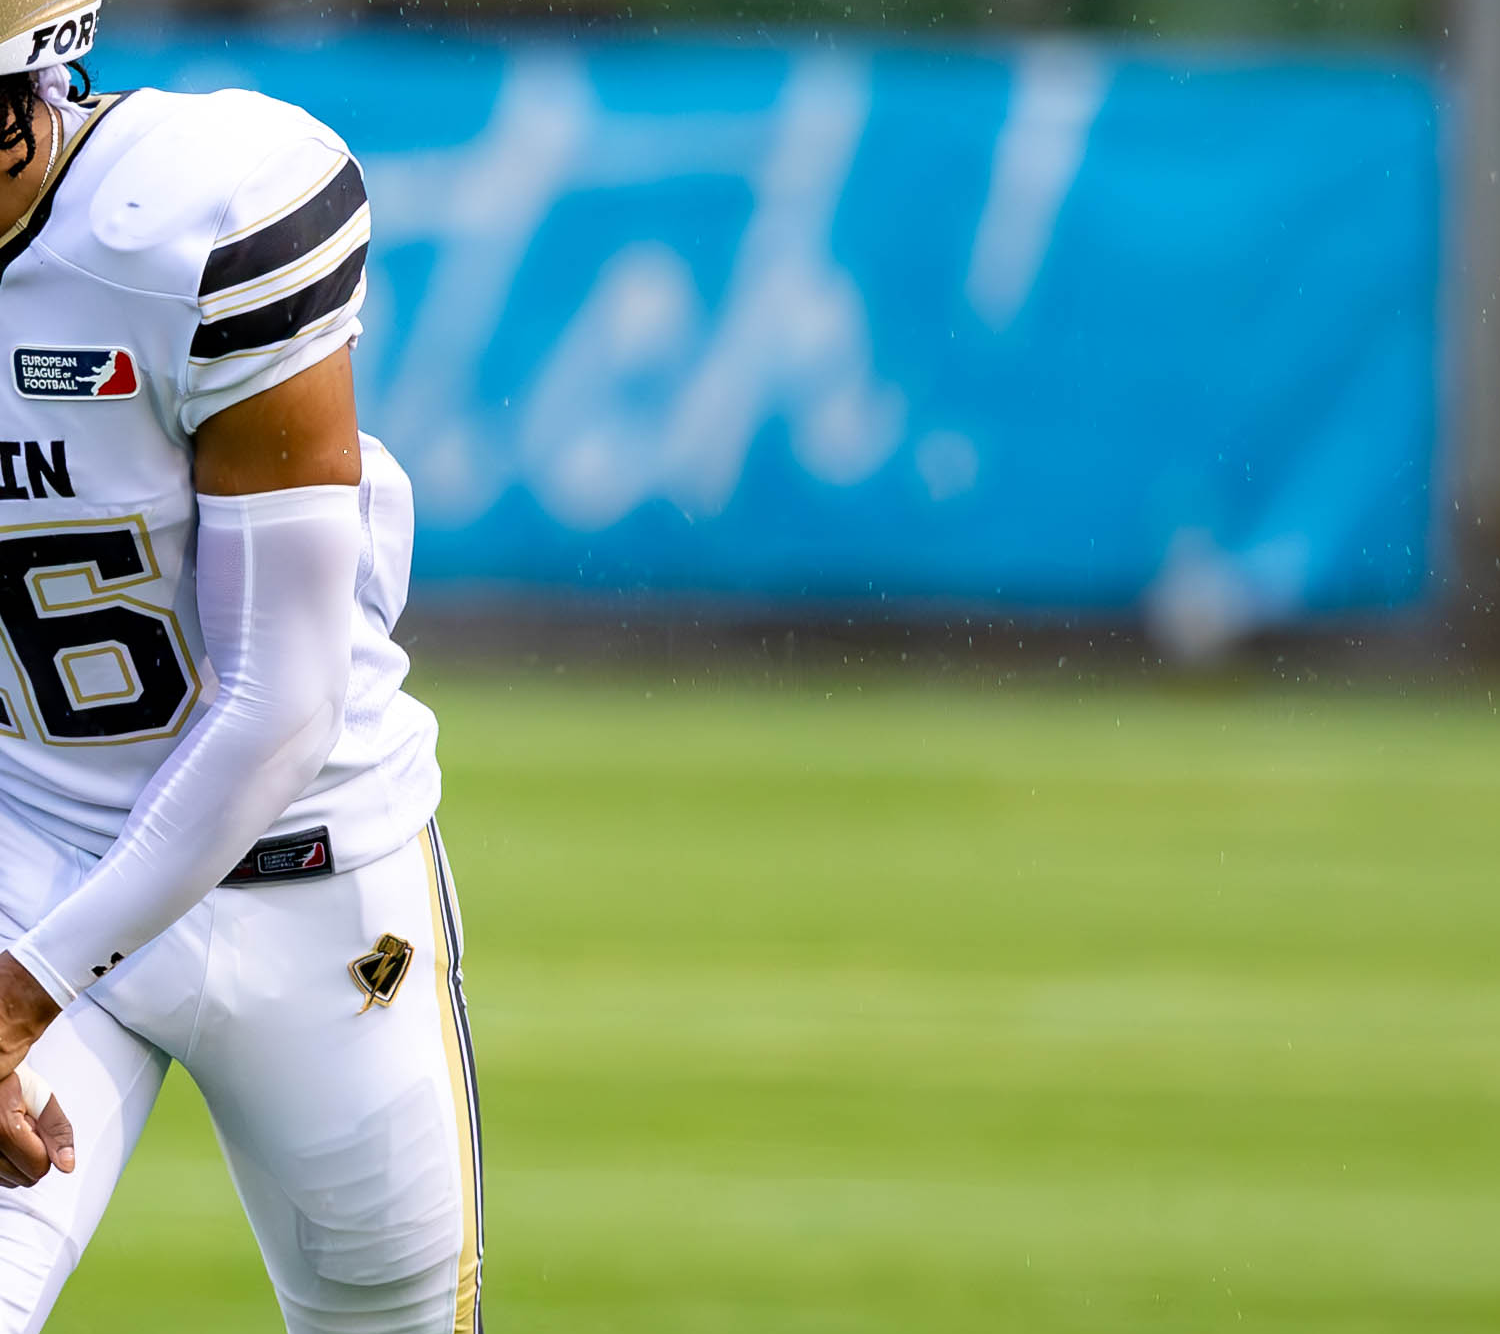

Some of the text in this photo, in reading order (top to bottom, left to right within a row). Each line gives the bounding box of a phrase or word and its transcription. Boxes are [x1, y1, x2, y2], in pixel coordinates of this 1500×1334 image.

[26, 11, 98, 66] FOR
[21, 354, 78, 368] EUROPEAN
[22, 366, 62, 379] LEAGUE
[24, 378, 79, 391] FOOTBALL
